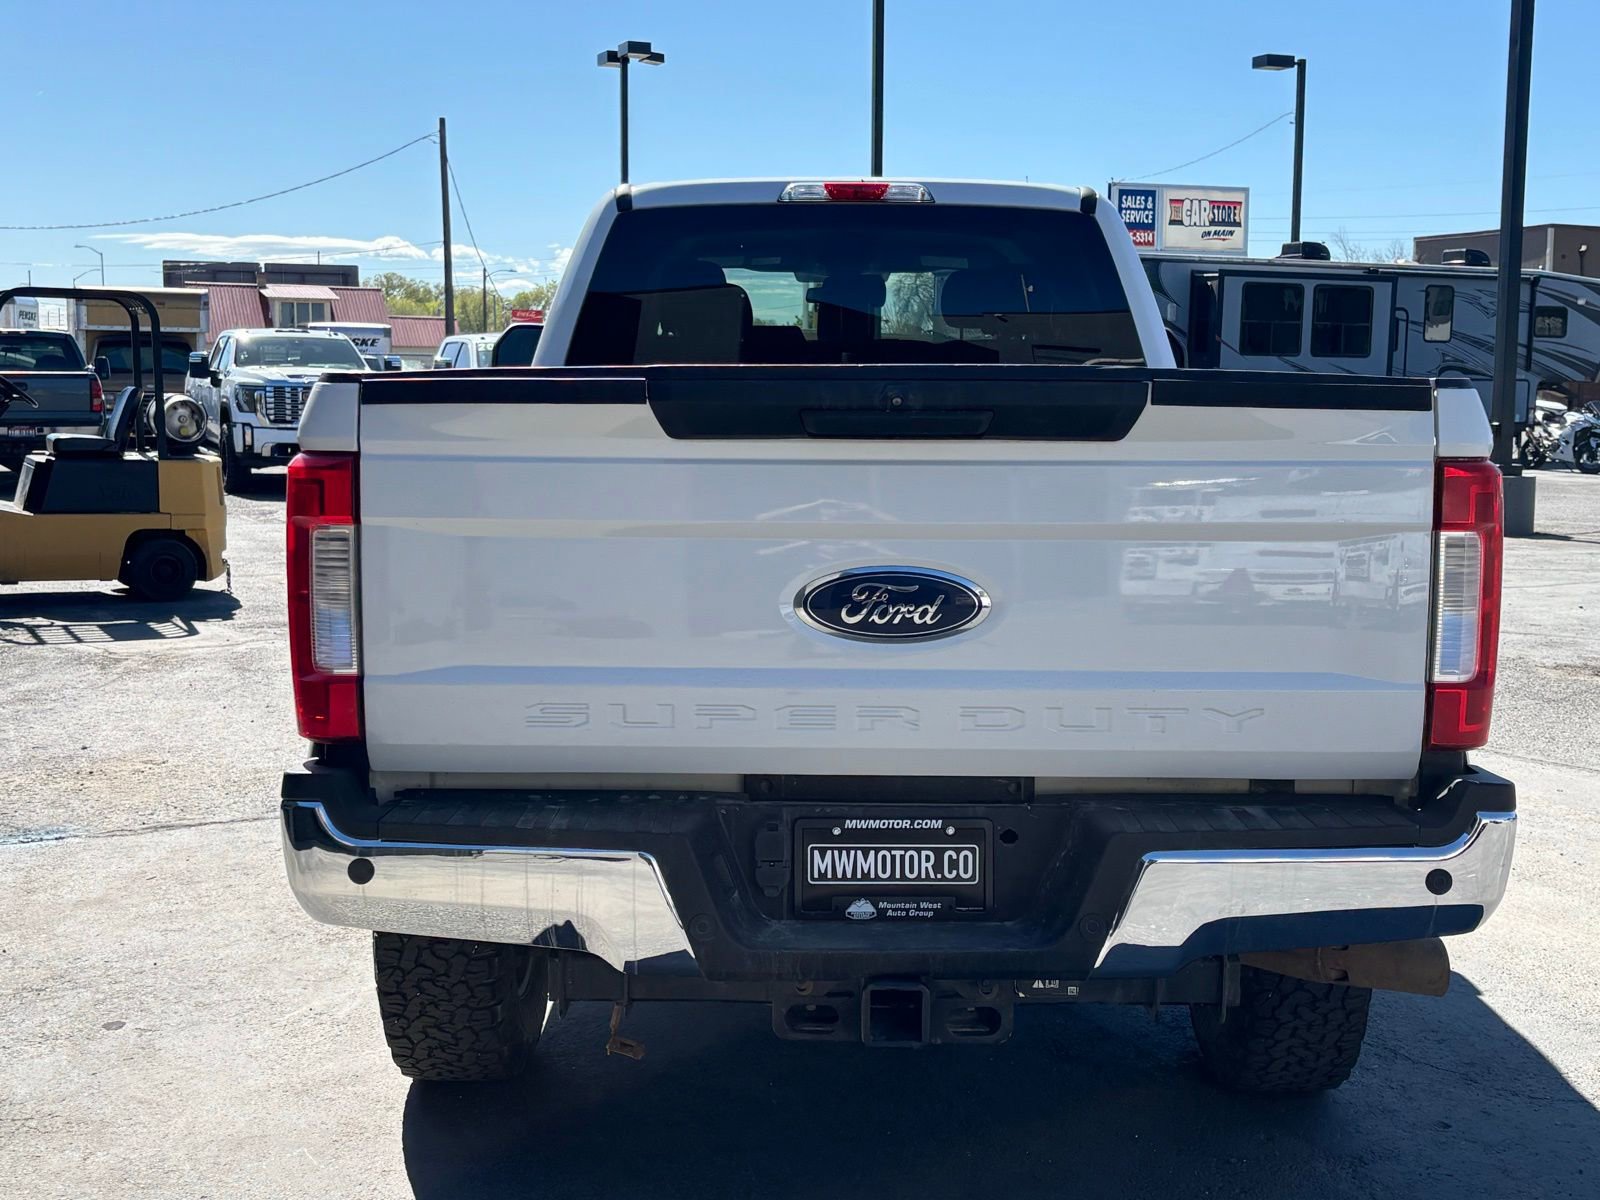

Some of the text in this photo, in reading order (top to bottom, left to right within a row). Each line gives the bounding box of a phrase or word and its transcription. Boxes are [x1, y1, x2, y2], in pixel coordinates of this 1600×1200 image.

[1121, 195, 1153, 209] SALES &
[1121, 210, 1153, 223] SERVICE
[1182, 198, 1210, 227] CAR
[1211, 205, 1240, 222] STORE
[1201, 229, 1234, 238] ON MAIN
[349, 338, 381, 347] SKE
[840, 583, 945, 625] Ford
[525, 702, 1265, 734] SUPER DUTY
[844, 819, 942, 829] MWMOTOR.COM
[813, 850, 973, 879] MWMOTOR.CO
[909, 910, 934, 918] Group
